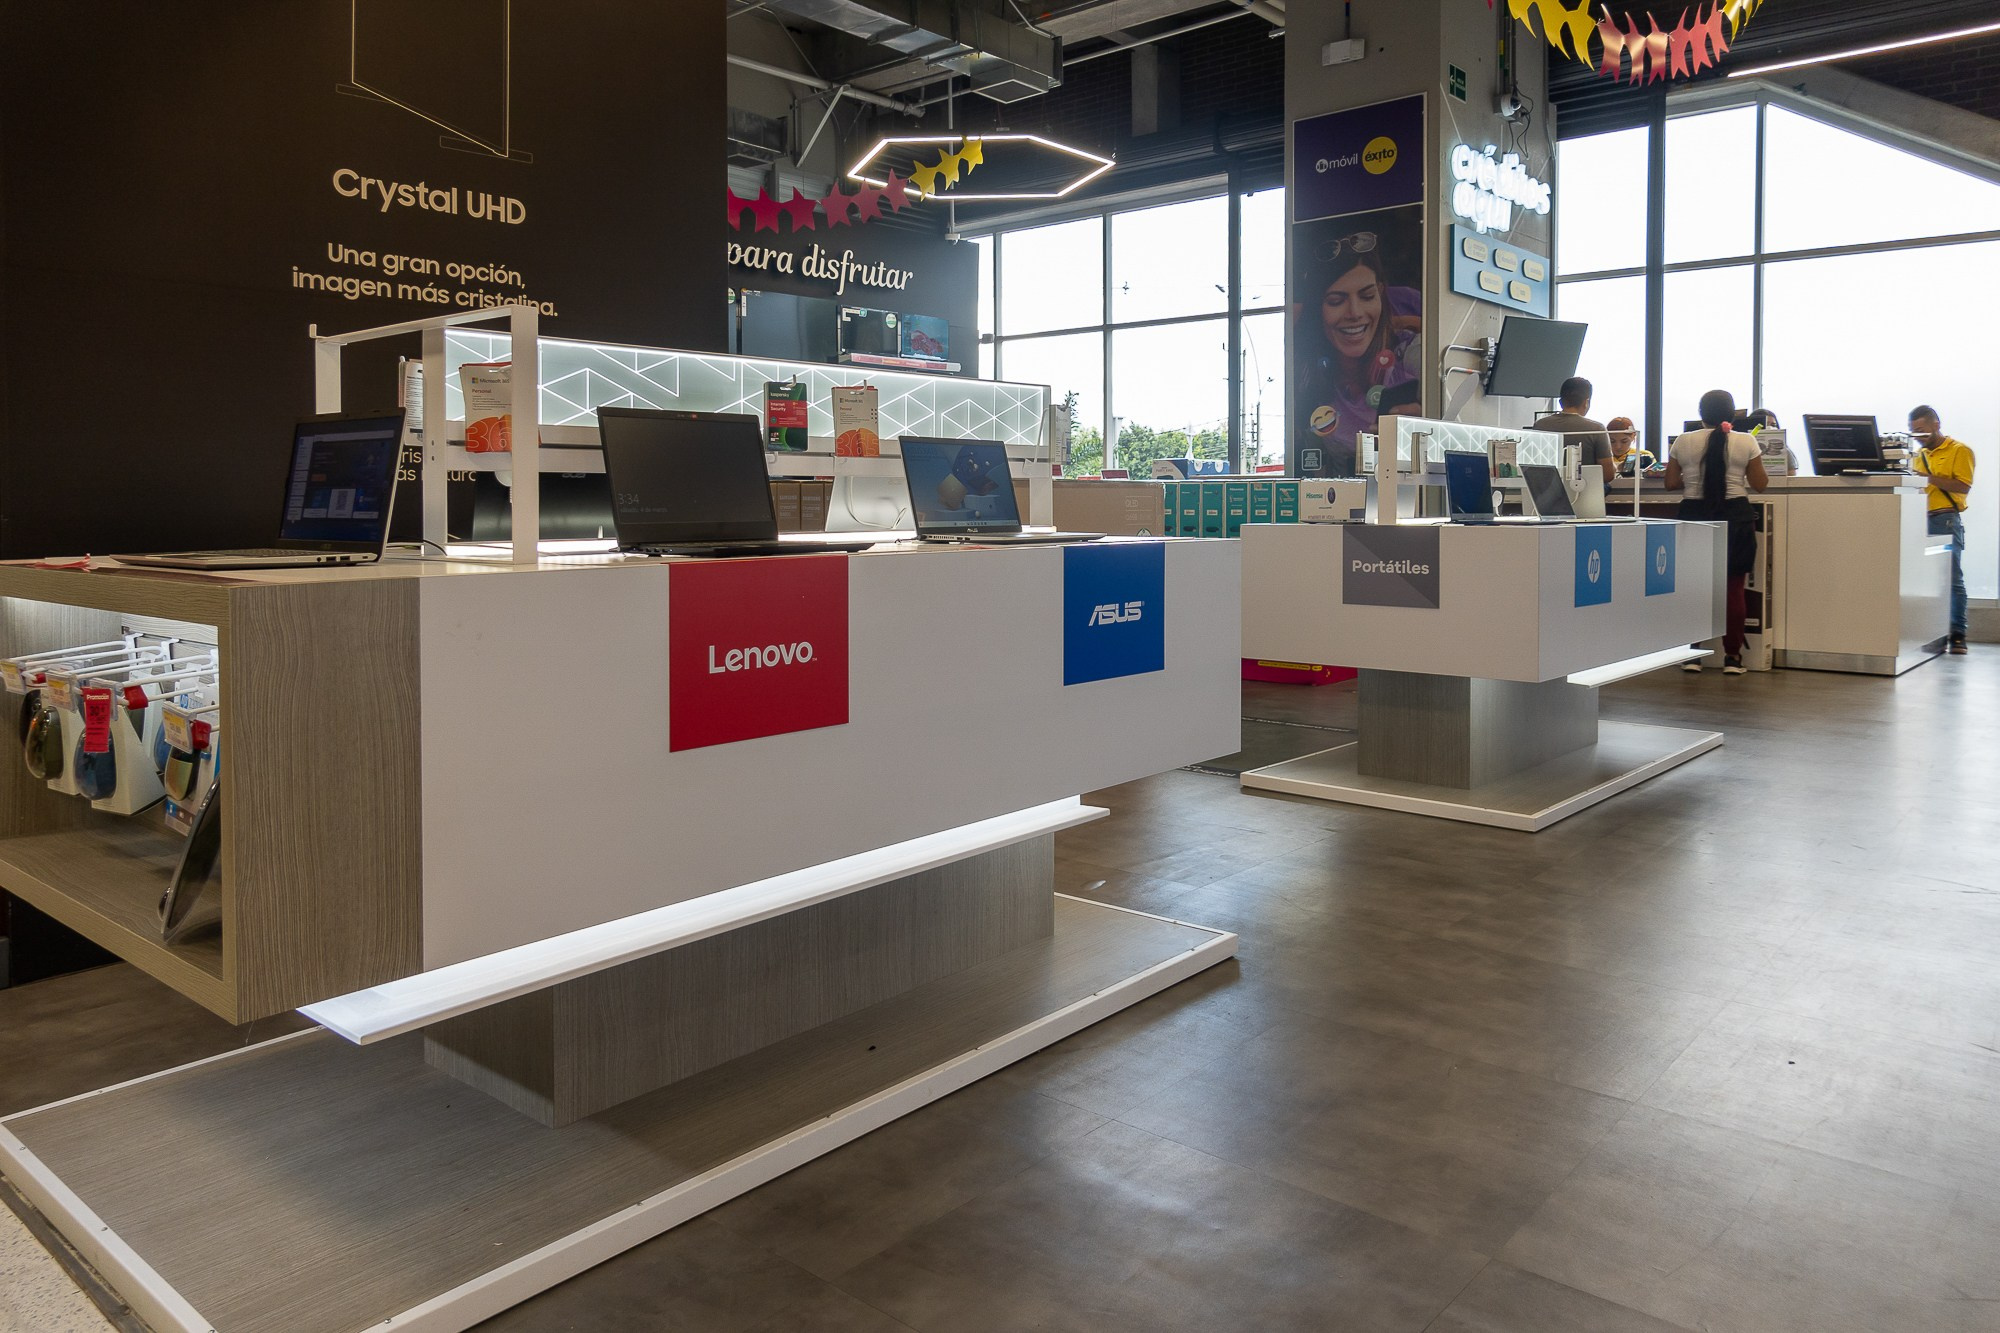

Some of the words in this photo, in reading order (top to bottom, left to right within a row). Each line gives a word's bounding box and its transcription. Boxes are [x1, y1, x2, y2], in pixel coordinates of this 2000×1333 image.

[1329, 153, 1358, 169] móvil
[1364, 148, 1395, 163] éxito
[332, 168, 458, 215] Crystal
[467, 190, 527, 225] UHD
[327, 242, 377, 268] Una
[382, 252, 441, 276] gran
[445, 263, 526, 289] opción,
[801, 243, 914, 296] disfrutar
[292, 265, 392, 301] imagen
[398, 281, 450, 304] más
[396, 465, 417, 481] ás
[1352, 559, 1430, 575] Portátiles
[1088, 601, 1142, 627] ASUS
[709, 641, 813, 674] Lenovo
